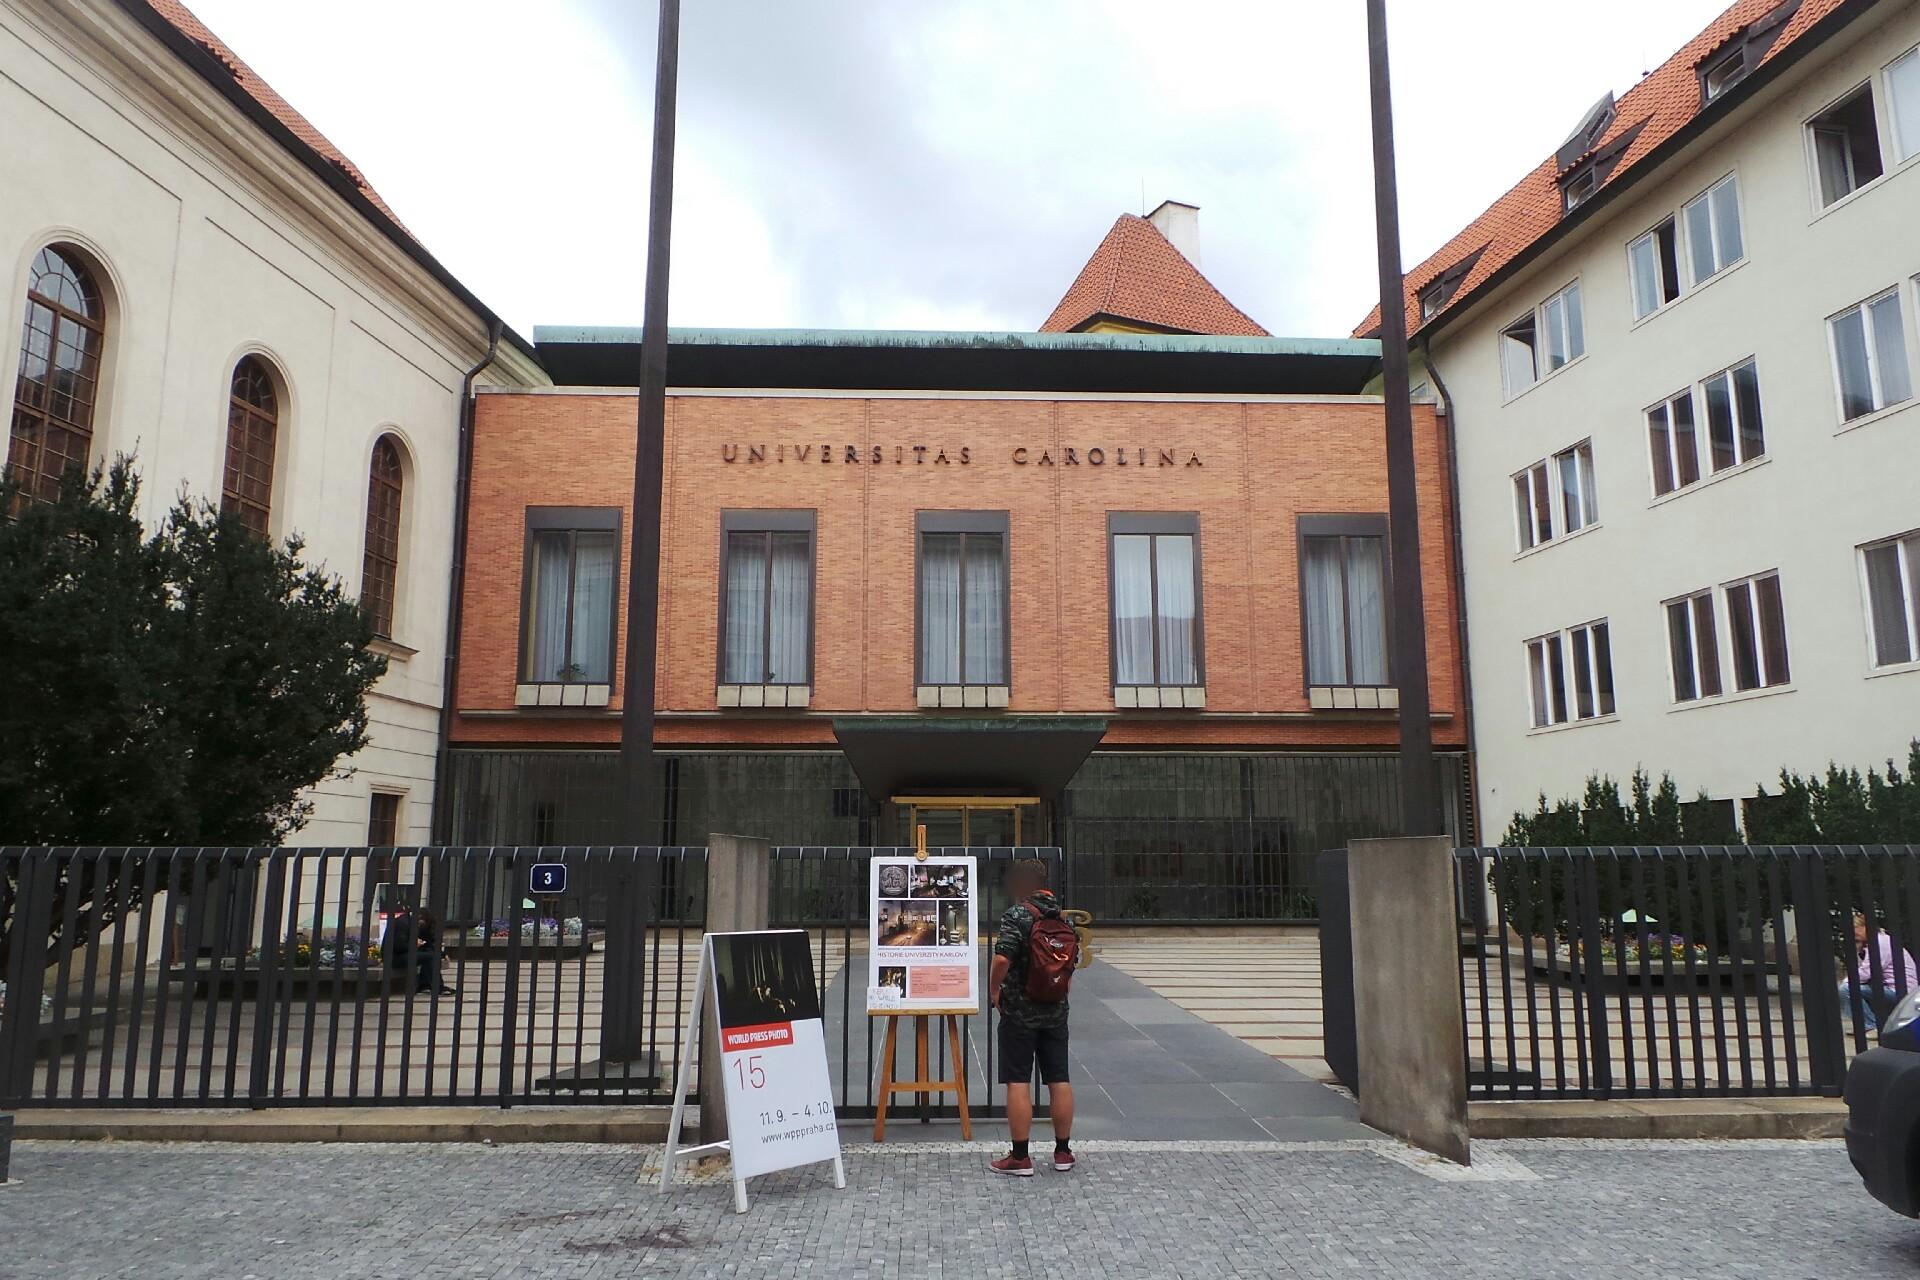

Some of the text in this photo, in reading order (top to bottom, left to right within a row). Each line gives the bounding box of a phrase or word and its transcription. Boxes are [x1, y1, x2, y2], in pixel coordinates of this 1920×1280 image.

[721, 443, 1204, 467] UNIVERSITAS CAROLINA
[544, 872, 552, 885] 3
[877, 951, 904, 959] HISTORIE
[940, 951, 968, 959] KARLOVY
[727, 1028, 789, 1046] WORLD PRESS PHOTO
[733, 1055, 766, 1091] 15
[761, 1122, 835, 1144] www.wpppraha.cz
